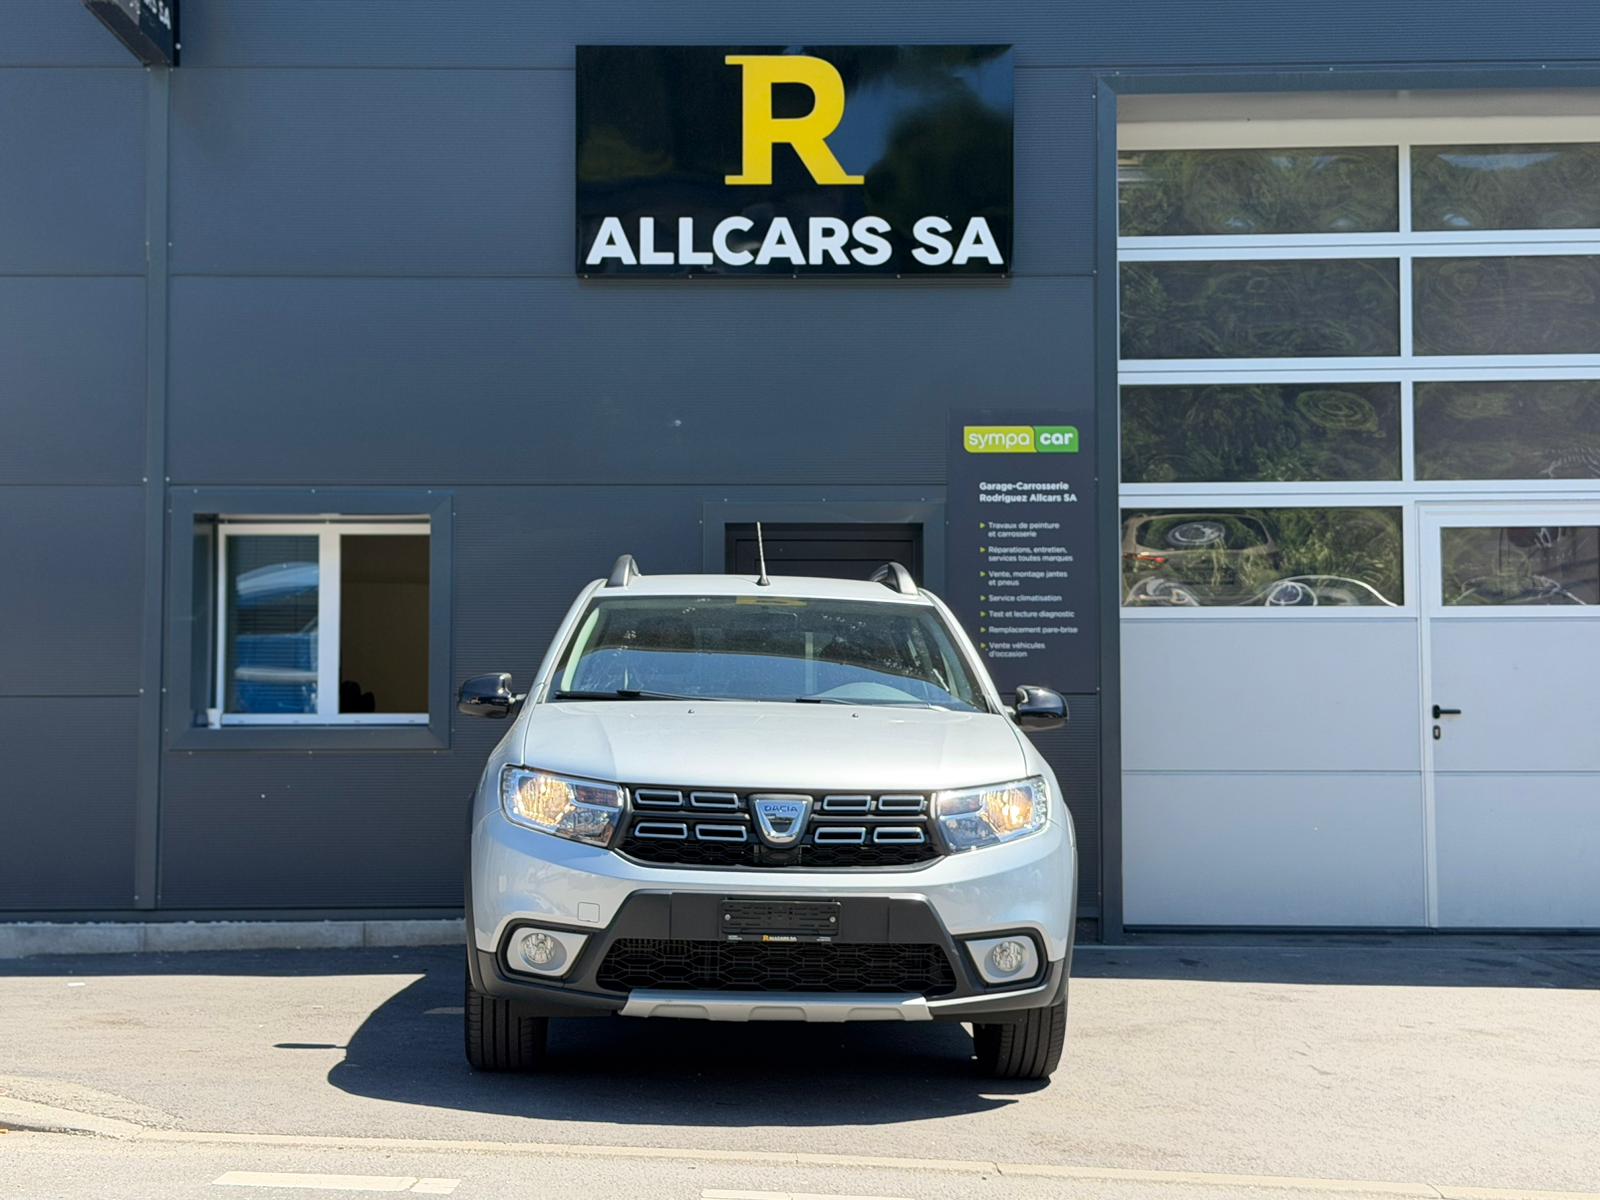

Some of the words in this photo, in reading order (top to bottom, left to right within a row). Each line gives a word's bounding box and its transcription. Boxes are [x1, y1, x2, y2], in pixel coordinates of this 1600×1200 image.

[724, 54, 865, 186] R
[585, 216, 893, 266] ALLCARS
[911, 216, 1004, 265] SA
[968, 432, 1031, 449] sympa
[1040, 432, 1073, 445] car
[979, 482, 1069, 492] Garage-Carrosserie
[979, 493, 1027, 503] Rodriguez
[1029, 493, 1062, 502] Allcars
[1063, 493, 1078, 502] SA
[988, 521, 1017, 529] Travaux
[1018, 521, 1028, 529] de
[1029, 522, 1060, 530] peinture
[988, 530, 996, 538] et
[997, 530, 1037, 538] carrosserie
[988, 546, 1032, 555] Réparations,
[1042, 555, 1073, 563] marques
[988, 570, 1012, 579] Vente,
[1013, 570, 1045, 578] montage
[1046, 570, 1068, 578] jantes
[1016, 594, 1062, 602] climatisation
[989, 610, 1005, 618] Test
[1014, 610, 1038, 618] lecture
[1039, 610, 1075, 619] diagnostic
[988, 626, 1041, 634] Remplacement
[1042, 626, 1078, 635] pare-brise
[1012, 641, 1045, 649] véhicules
